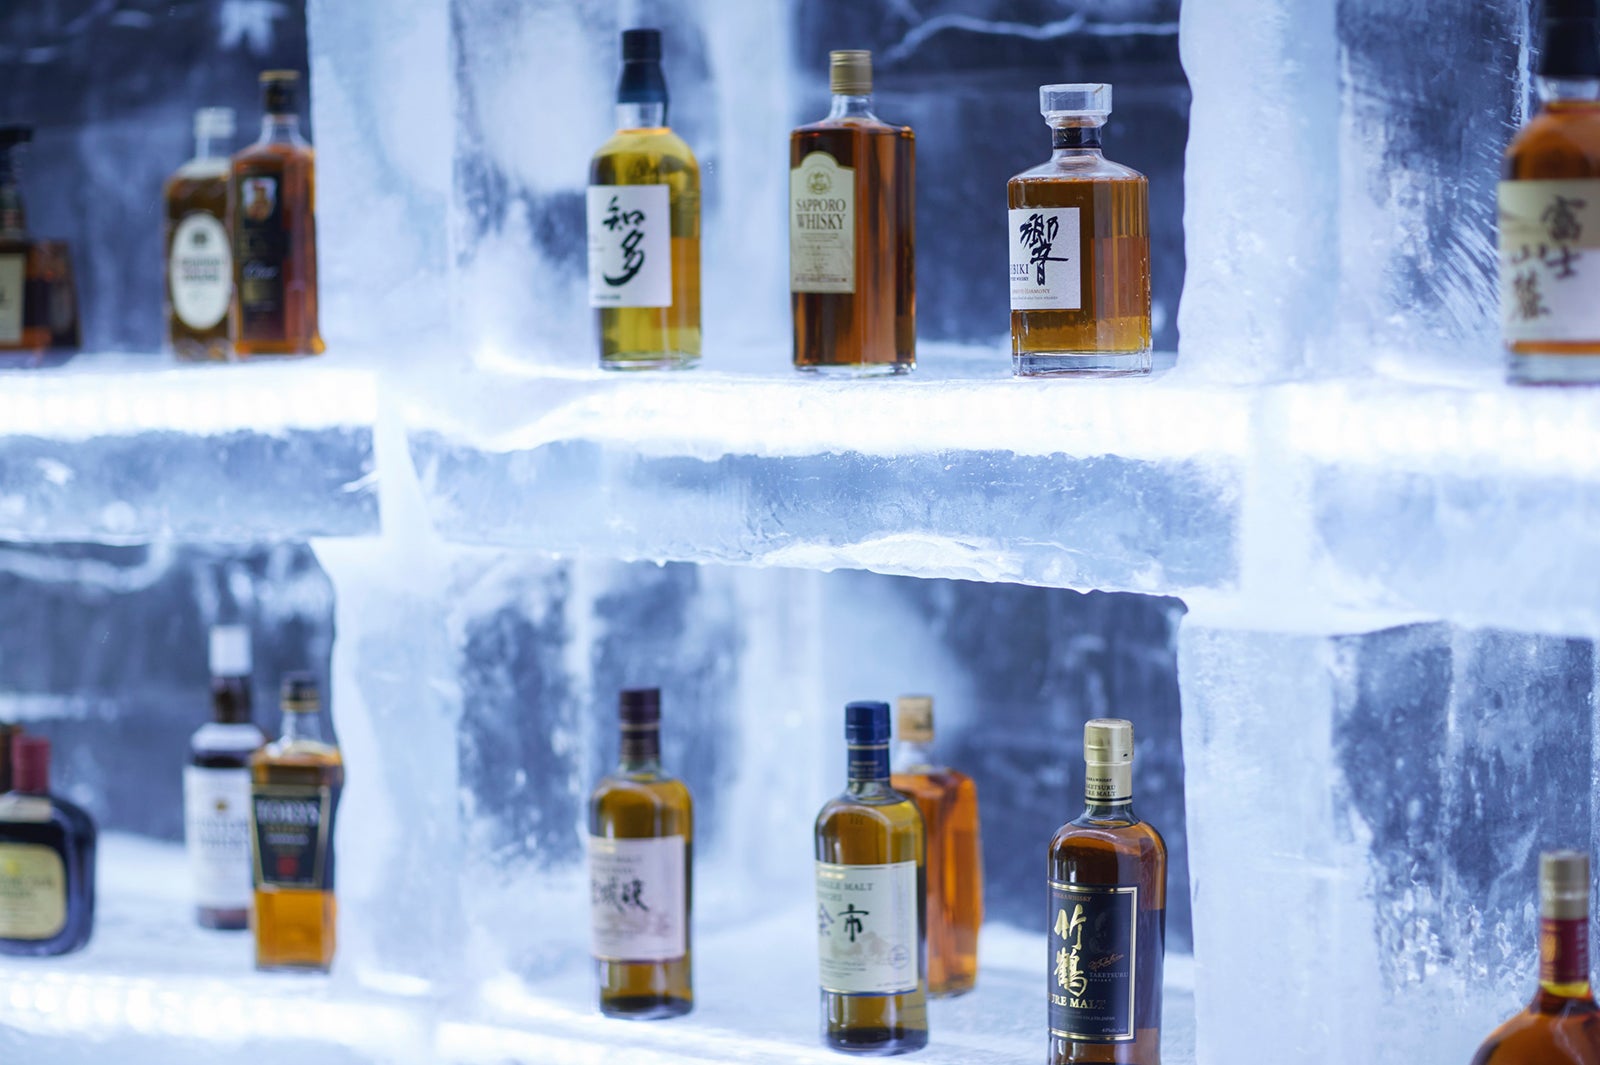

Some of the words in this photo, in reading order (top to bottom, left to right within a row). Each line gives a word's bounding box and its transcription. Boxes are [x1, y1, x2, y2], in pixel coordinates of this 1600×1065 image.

[795, 198, 847, 213] SAPPORO
[796, 213, 846, 230] WHISKY
[602, 194, 645, 286] 知多
[1019, 213, 1069, 286] 響
[844, 882, 874, 891] MALT
[1054, 903, 1089, 997] 竹鶴
[1069, 997, 1106, 1010] MALT
